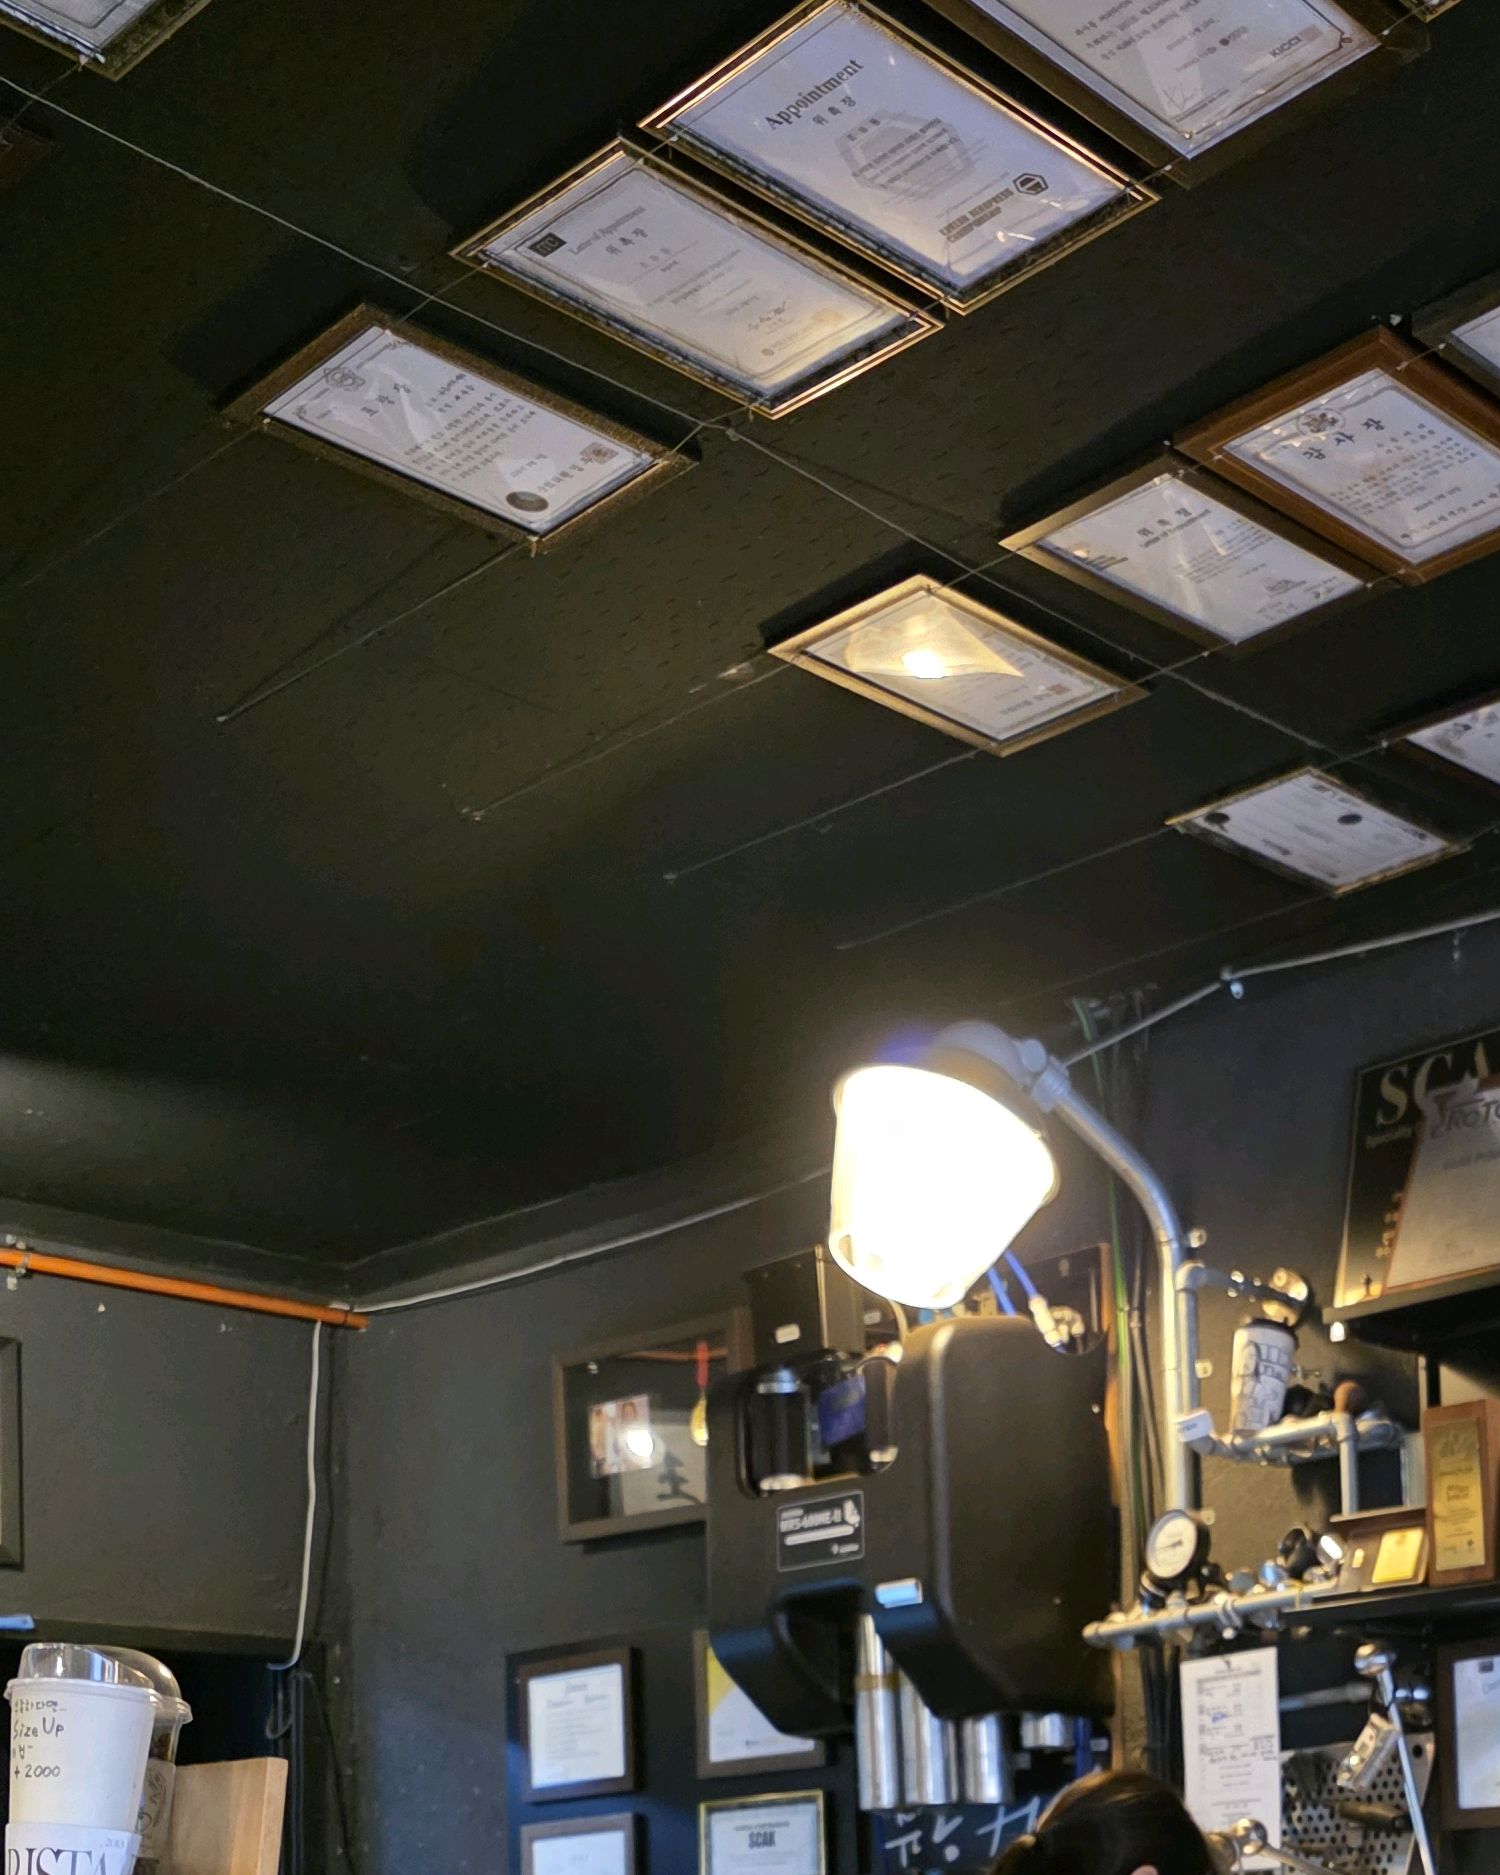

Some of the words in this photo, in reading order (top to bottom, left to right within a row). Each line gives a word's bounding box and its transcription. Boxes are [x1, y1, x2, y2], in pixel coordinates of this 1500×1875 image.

[764, 57, 864, 130] Appointment
[42, 1716, 65, 1738] Up
[24, 1764, 61, 1779] 2000
[748, 1829, 776, 1850] SCAK
